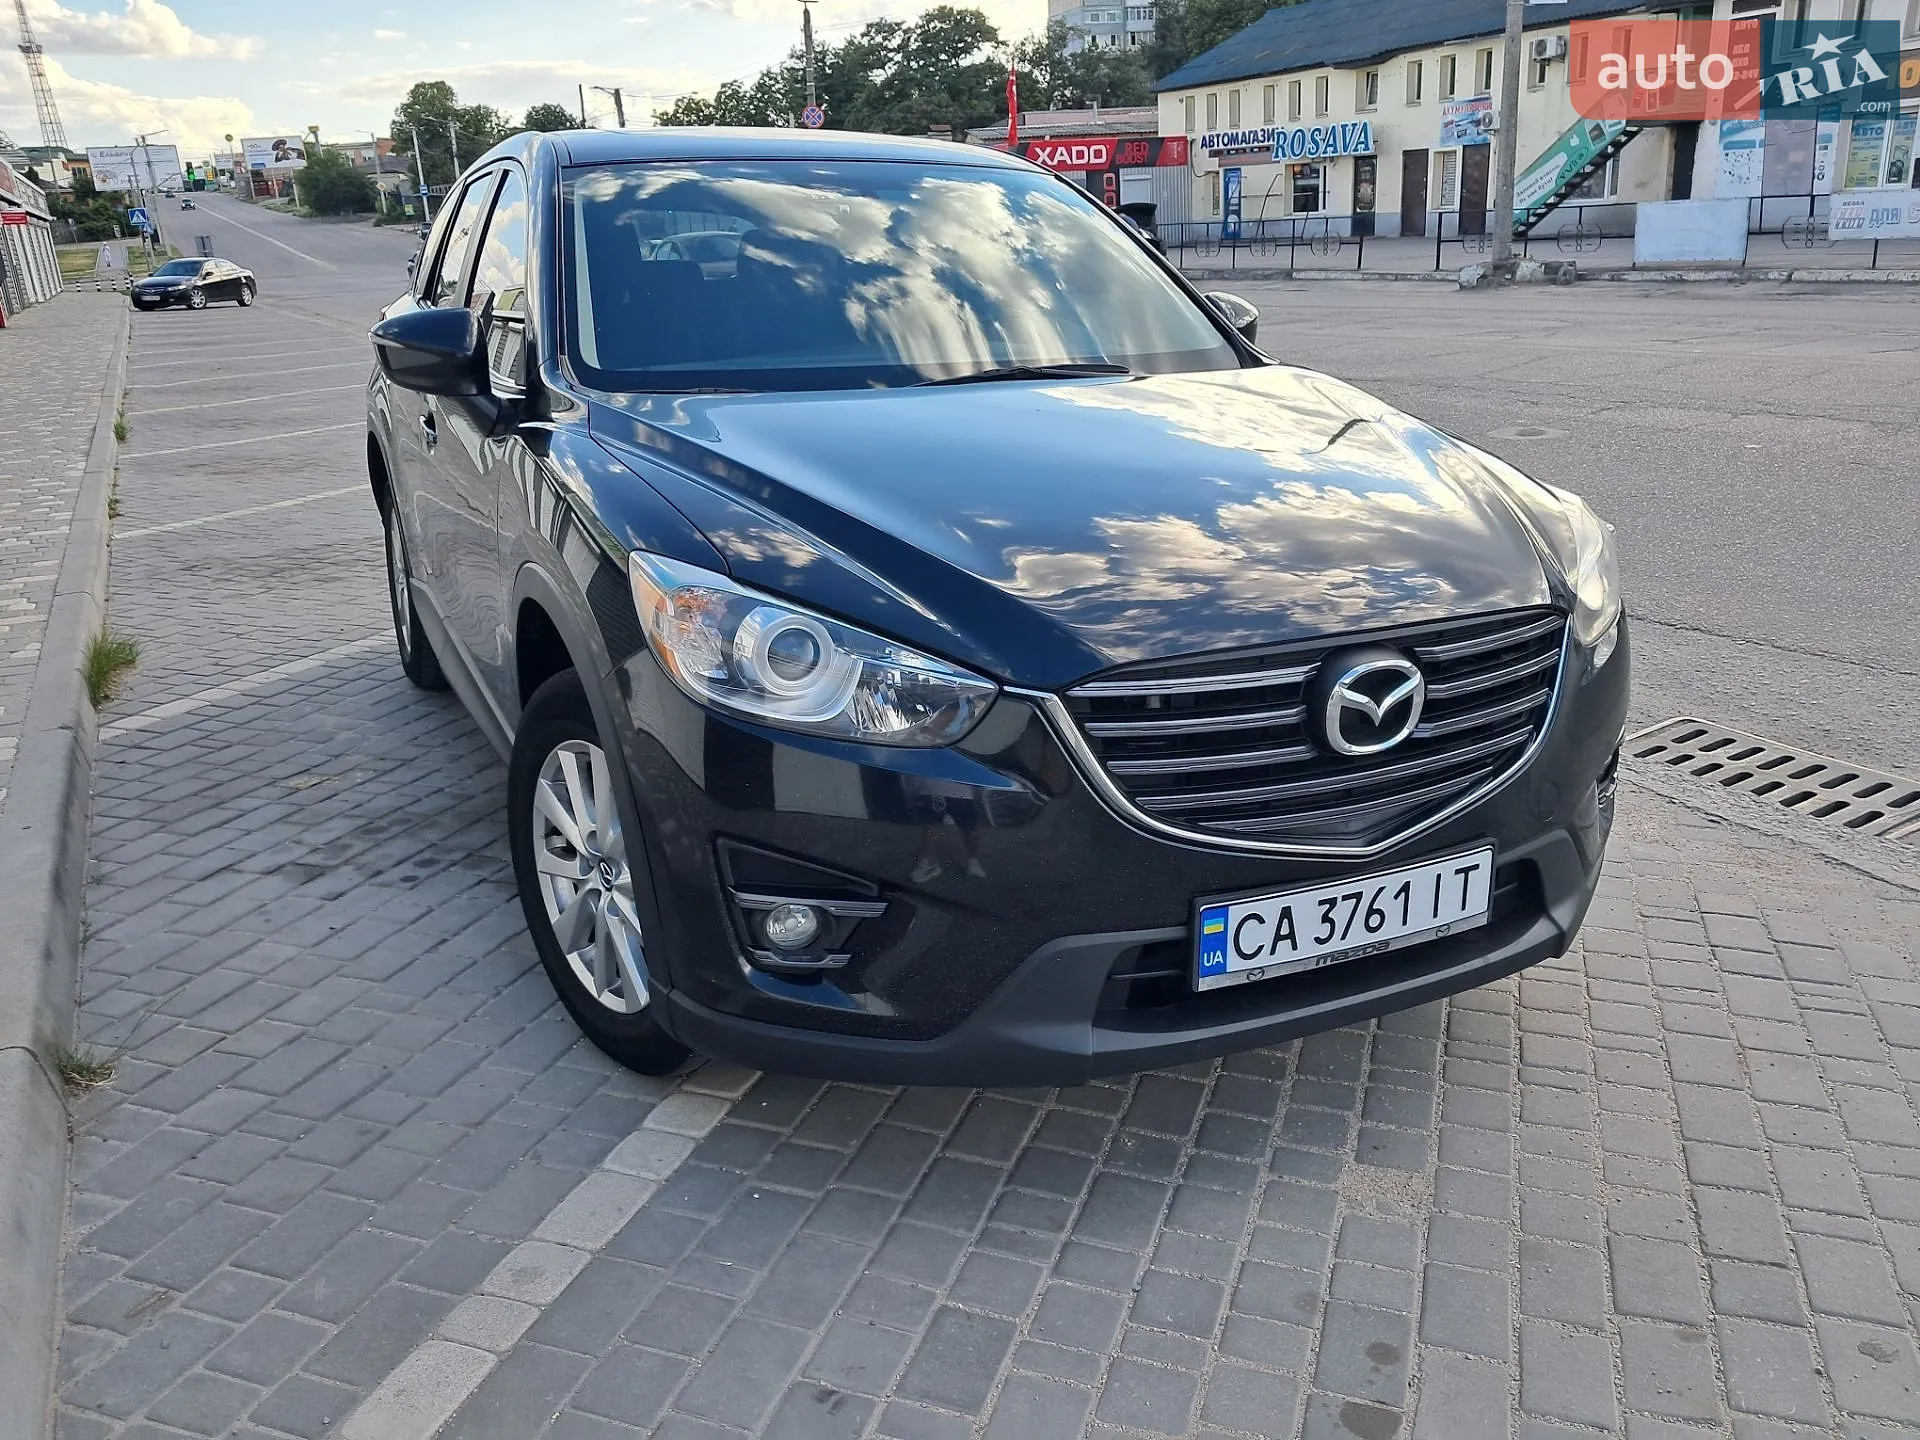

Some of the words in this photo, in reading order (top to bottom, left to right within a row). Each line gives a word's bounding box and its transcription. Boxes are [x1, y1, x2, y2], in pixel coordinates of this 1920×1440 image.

[1733, 69, 1760, 81] 2-24V
[1125, 142, 1149, 152] RED
[1200, 126, 1284, 149] АВТОМАГАЗИ
[1273, 121, 1372, 159] ROSAVA
[1034, 144, 1107, 165] XADO
[1116, 153, 1149, 164] BOOST
[1869, 208, 1901, 228] ДЛЯ
[1233, 905, 1298, 961] CA
[1313, 880, 1412, 946] 3761
[1432, 863, 1481, 919] IT
[1203, 950, 1224, 967] UA
